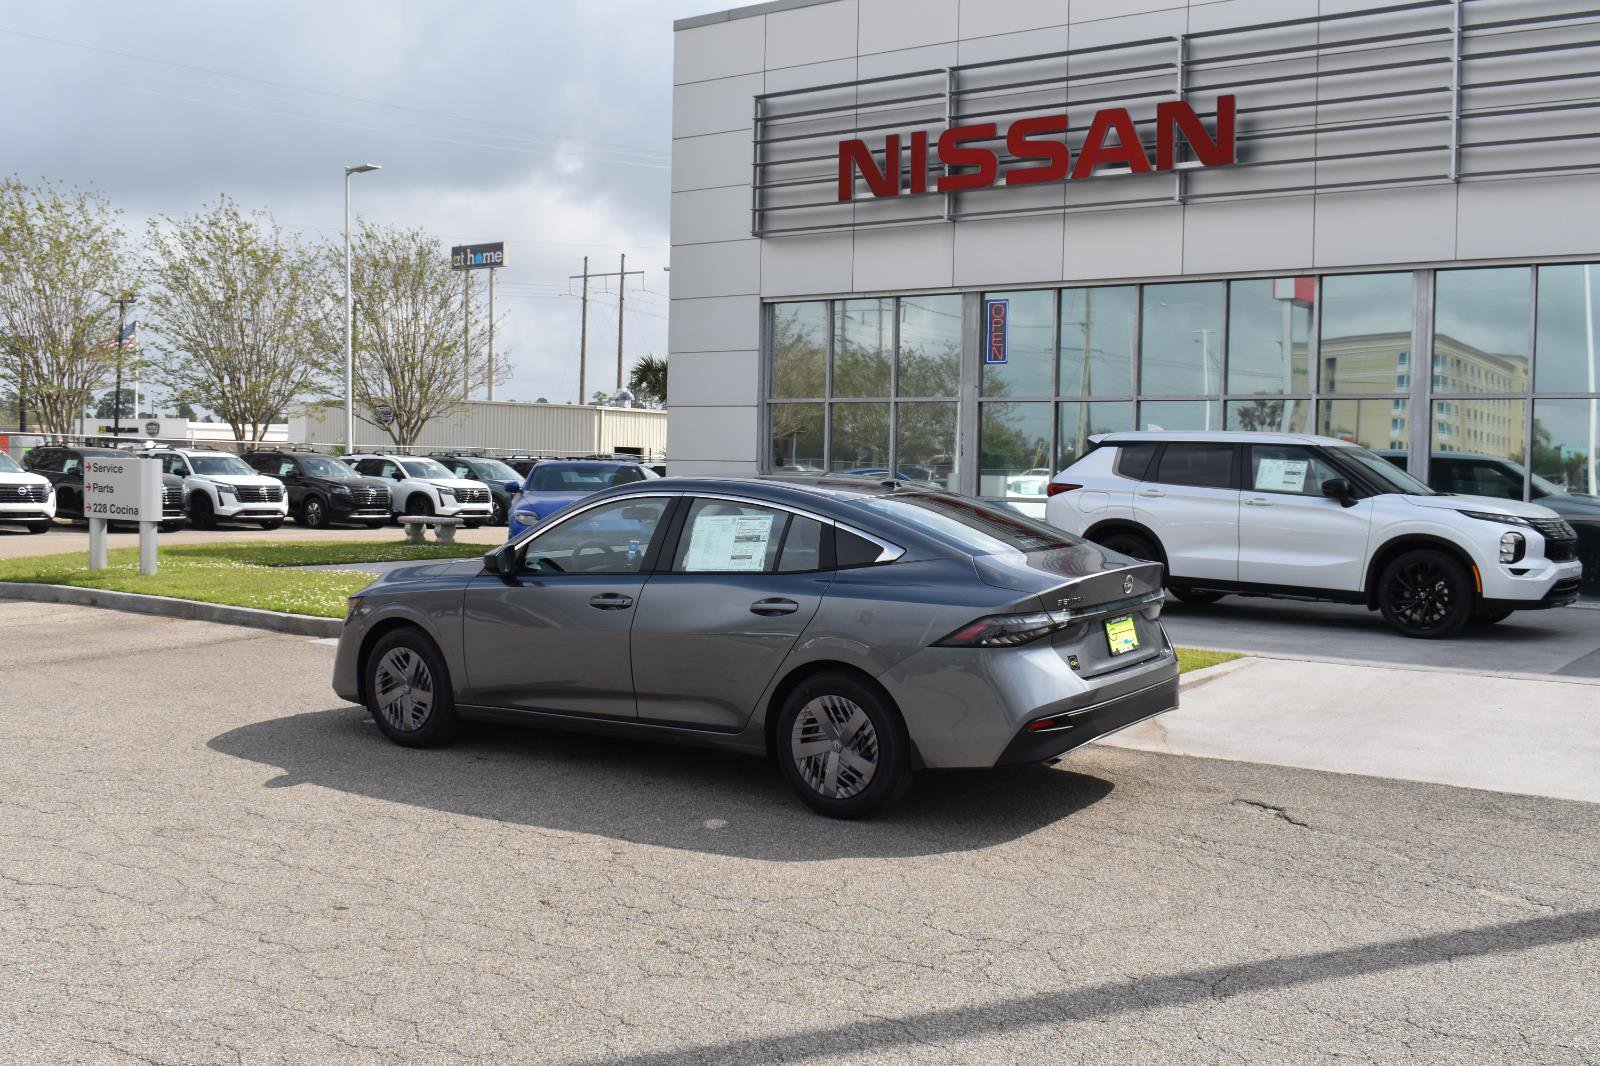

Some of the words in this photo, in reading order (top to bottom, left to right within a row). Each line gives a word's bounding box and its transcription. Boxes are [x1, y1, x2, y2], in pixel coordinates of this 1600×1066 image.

[838, 93, 1237, 202] NISSAN
[991, 303, 1005, 360] OPEN
[92, 462, 124, 474] Service
[92, 482, 115, 494] Parts
[93, 503, 108, 514] 228
[109, 503, 139, 516] Cocina
